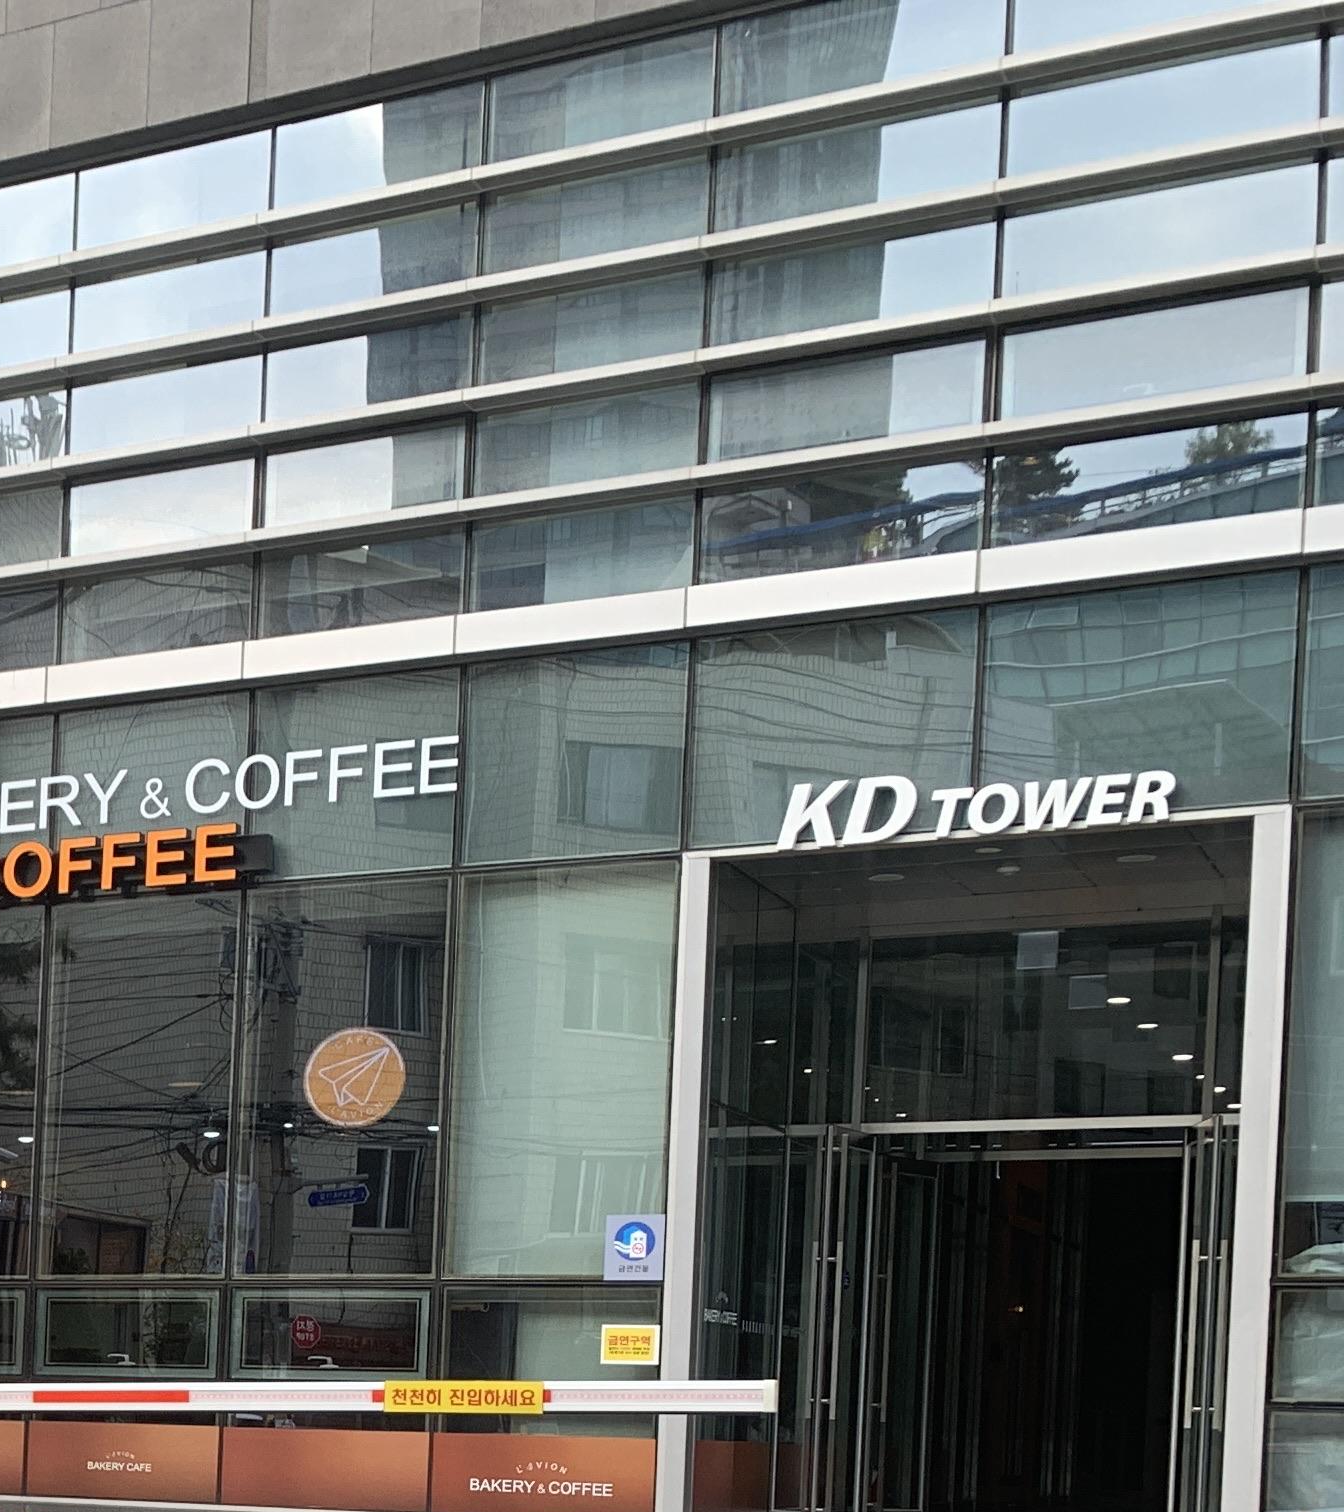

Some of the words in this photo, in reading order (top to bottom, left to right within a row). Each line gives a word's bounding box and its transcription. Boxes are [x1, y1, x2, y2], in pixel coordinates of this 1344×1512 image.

[140, 778, 171, 818] &
[184, 735, 459, 814] COFFEE
[776, 775, 917, 852] KD
[930, 770, 1177, 839] TOWER
[391, 1388, 441, 1406] 천천히
[449, 1388, 536, 1407] 진입하세요
[87, 1461, 124, 1471] BAKERY
[126, 1462, 152, 1472] CAFE
[469, 1478, 535, 1493] BAKERY
[537, 1483, 546, 1494] &
[548, 1481, 613, 1497] COFFEE
